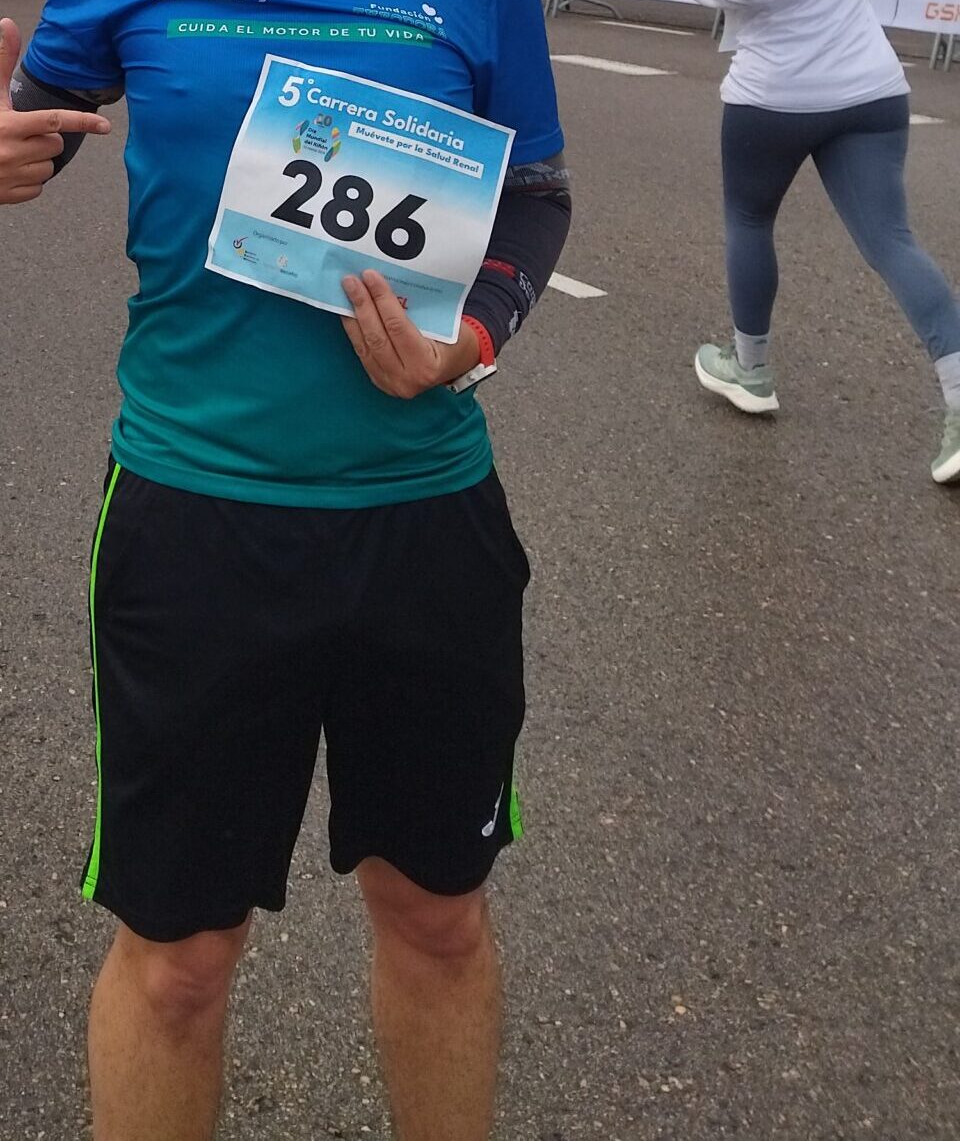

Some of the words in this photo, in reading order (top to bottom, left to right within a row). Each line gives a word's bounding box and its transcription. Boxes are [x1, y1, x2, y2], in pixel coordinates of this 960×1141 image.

[178, 23, 229, 33] CUIDA
[236, 25, 255, 34] EL
[263, 26, 321, 36] MOTOR
[330, 28, 350, 37] DE
[358, 28, 377, 37] TU
[385, 29, 424, 41] VIDA
[370, 3, 432, 22] Fundación
[307, 87, 378, 122] Carrera
[382, 109, 465, 151] Solidaria
[355, 126, 395, 144] Muévete
[396, 138, 413, 149] por
[414, 144, 424, 154] la
[425, 148, 451, 164] Salud
[452, 157, 479, 174] Renal
[270, 159, 428, 261] 286
